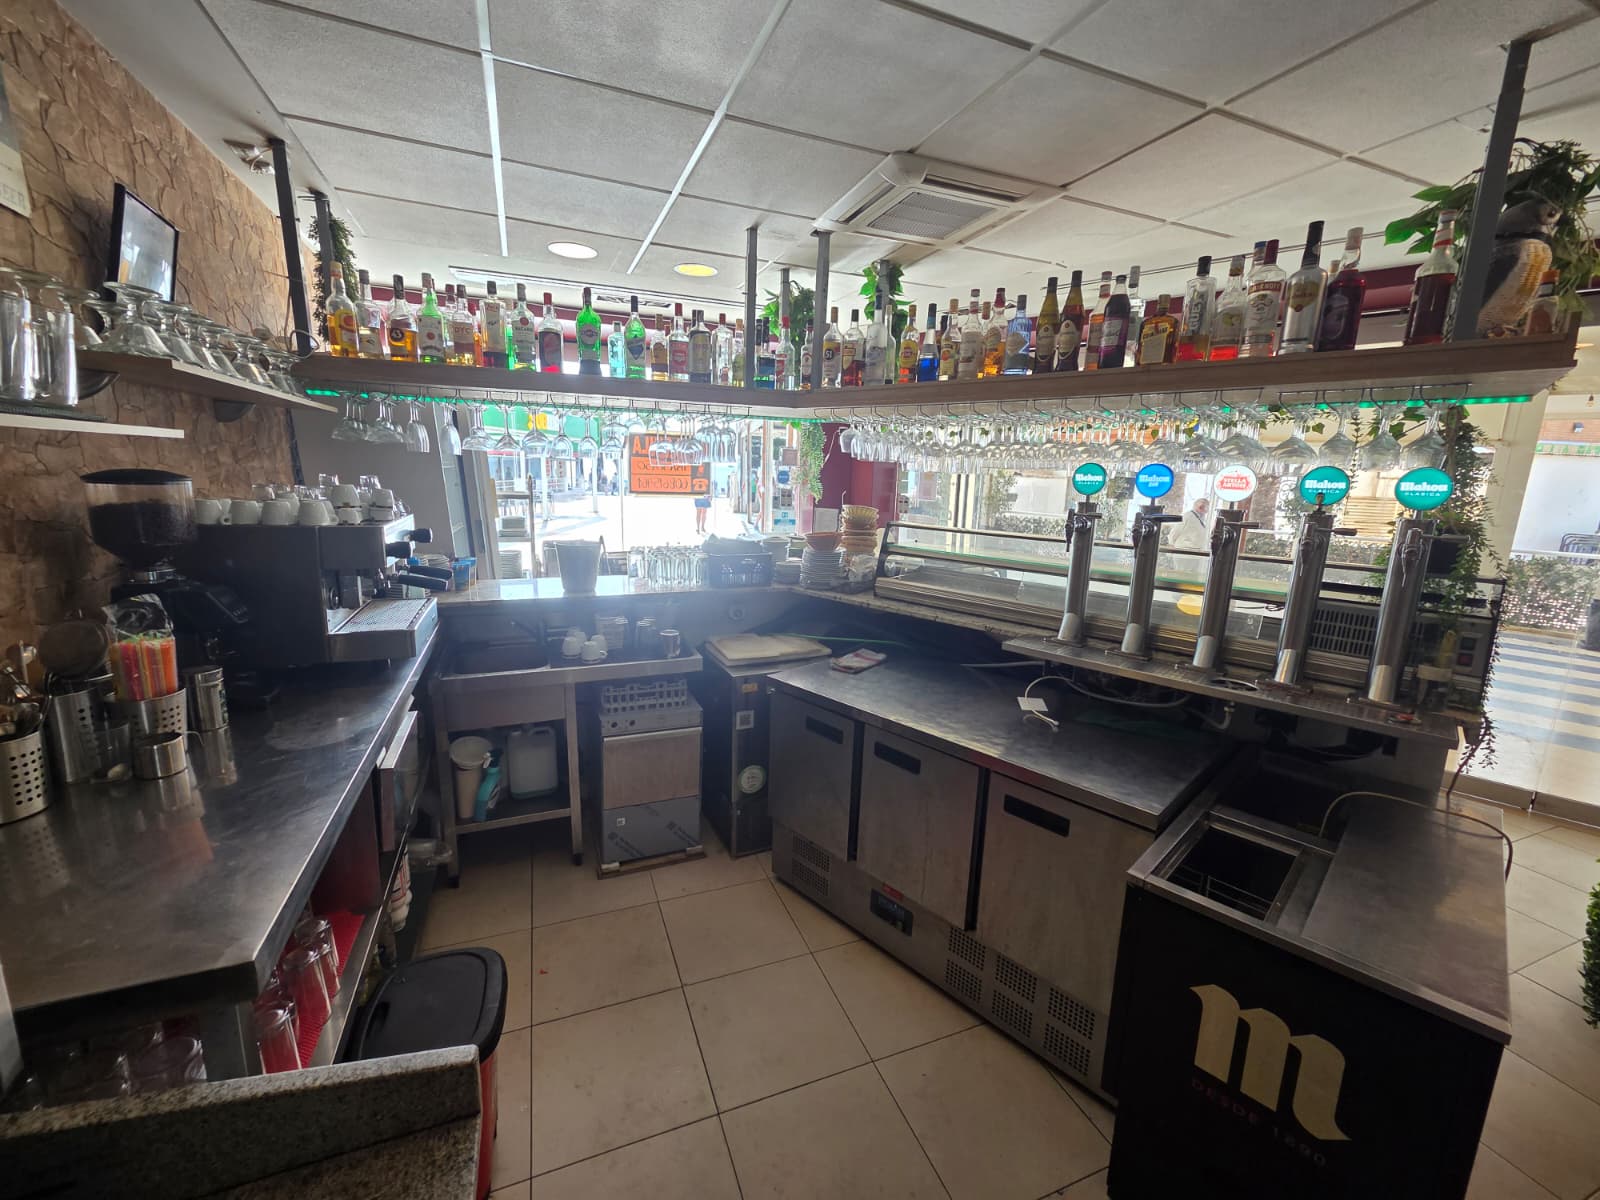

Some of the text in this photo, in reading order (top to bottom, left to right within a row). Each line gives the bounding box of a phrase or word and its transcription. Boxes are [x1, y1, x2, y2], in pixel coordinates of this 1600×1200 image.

[1075, 473, 1103, 482] Mahou
[1138, 474, 1170, 483] Mahou
[1304, 479, 1346, 489] Mahou
[1400, 481, 1449, 491] Mahou
